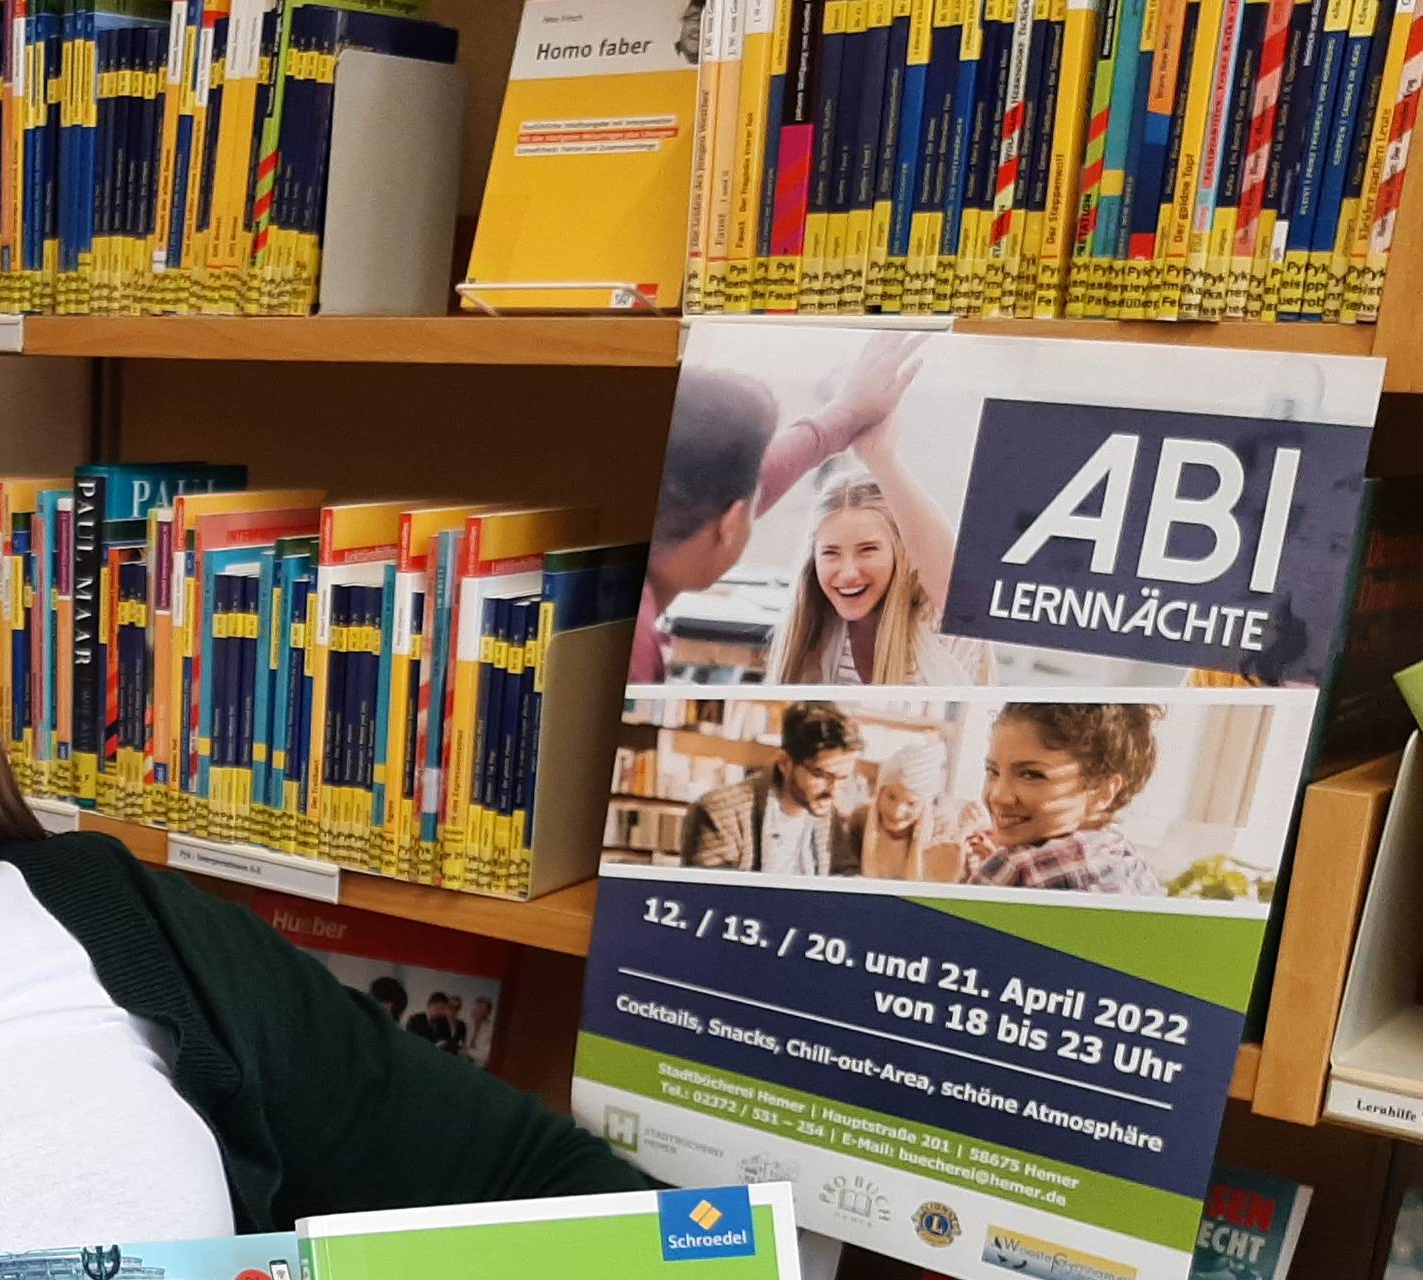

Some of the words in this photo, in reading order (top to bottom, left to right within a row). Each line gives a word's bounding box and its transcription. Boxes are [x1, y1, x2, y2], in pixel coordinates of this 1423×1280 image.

[536, 42, 592, 60] Homo
[598, 38, 652, 57] faber
[1048, 153, 1065, 221] Steppenwolf
[1181, 152, 1194, 178] Topf
[1365, 145, 1382, 195] machen
[1178, 181, 1191, 220] goldne
[735, 221, 746, 249] Faust
[1046, 225, 1056, 245] Der
[1174, 224, 1186, 243] Der
[77, 481, 96, 563] PAUL
[1001, 432, 1301, 595] ABI
[74, 576, 95, 666] MAAR
[989, 578, 1270, 651] LERNNÄCHTE
[272, 908, 349, 940] Hueber
[642, 897, 687, 930] 12.
[722, 915, 768, 948] 13.
[804, 933, 854, 967] 20.
[864, 951, 929, 984] und
[938, 962, 989, 998] 21.
[999, 977, 1085, 1021] April
[1094, 998, 1190, 1045] 2022
[874, 990, 935, 1024] von
[944, 1003, 989, 1037] 18
[996, 1014, 1048, 1052] bis
[1056, 1030, 1104, 1064] 23
[1113, 1042, 1183, 1084] Uhr
[615, 994, 704, 1035] Cocktails,
[707, 1018, 781, 1056] Snacks,
[785, 1038, 935, 1096] Chill-out-Area,
[940, 1080, 1019, 1115] schöne
[1022, 1100, 1164, 1154] Atmosphäre
[657, 1061, 755, 1100] Stadtbücherei
[756, 1089, 807, 1115] Hemer
[822, 1107, 918, 1146] Hauptstraße
[920, 1133, 951, 1155] 201
[968, 1147, 1022, 1174] 58675
[1023, 1162, 1081, 1190] Hemer
[1356, 1099, 1417, 1123] Lernhilfe
[692, 1089, 738, 1115] 02372
[841, 1132, 896, 1158] E-Mail:
[898, 1145, 1067, 1208] buecherei@hemer.de
[667, 1230, 748, 1250] Schroedel
